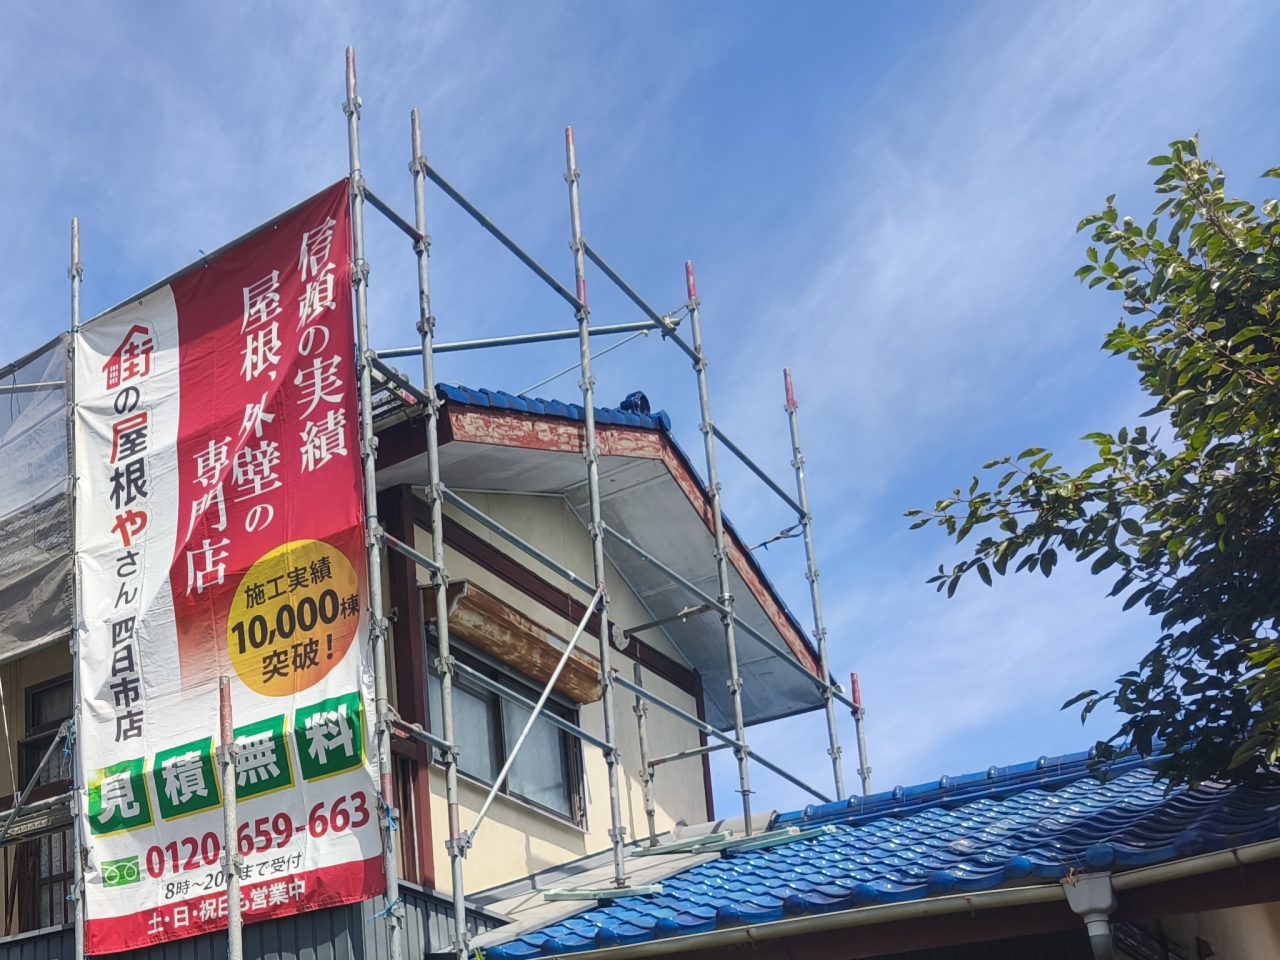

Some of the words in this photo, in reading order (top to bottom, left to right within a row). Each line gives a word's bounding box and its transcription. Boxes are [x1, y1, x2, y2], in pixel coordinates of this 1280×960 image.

[231, 269, 283, 532] 屋根、外壁の
[296, 216, 347, 472] 信頼の実績
[102, 324, 154, 609] 街の屋根やさん
[185, 436, 233, 598] 専門店
[231, 588, 360, 655] 10,000棟
[244, 555, 333, 610] 施工実績
[110, 615, 144, 743] 四日市店
[97, 703, 354, 825] 見積無料
[145, 790, 370, 879] 0120659-663
